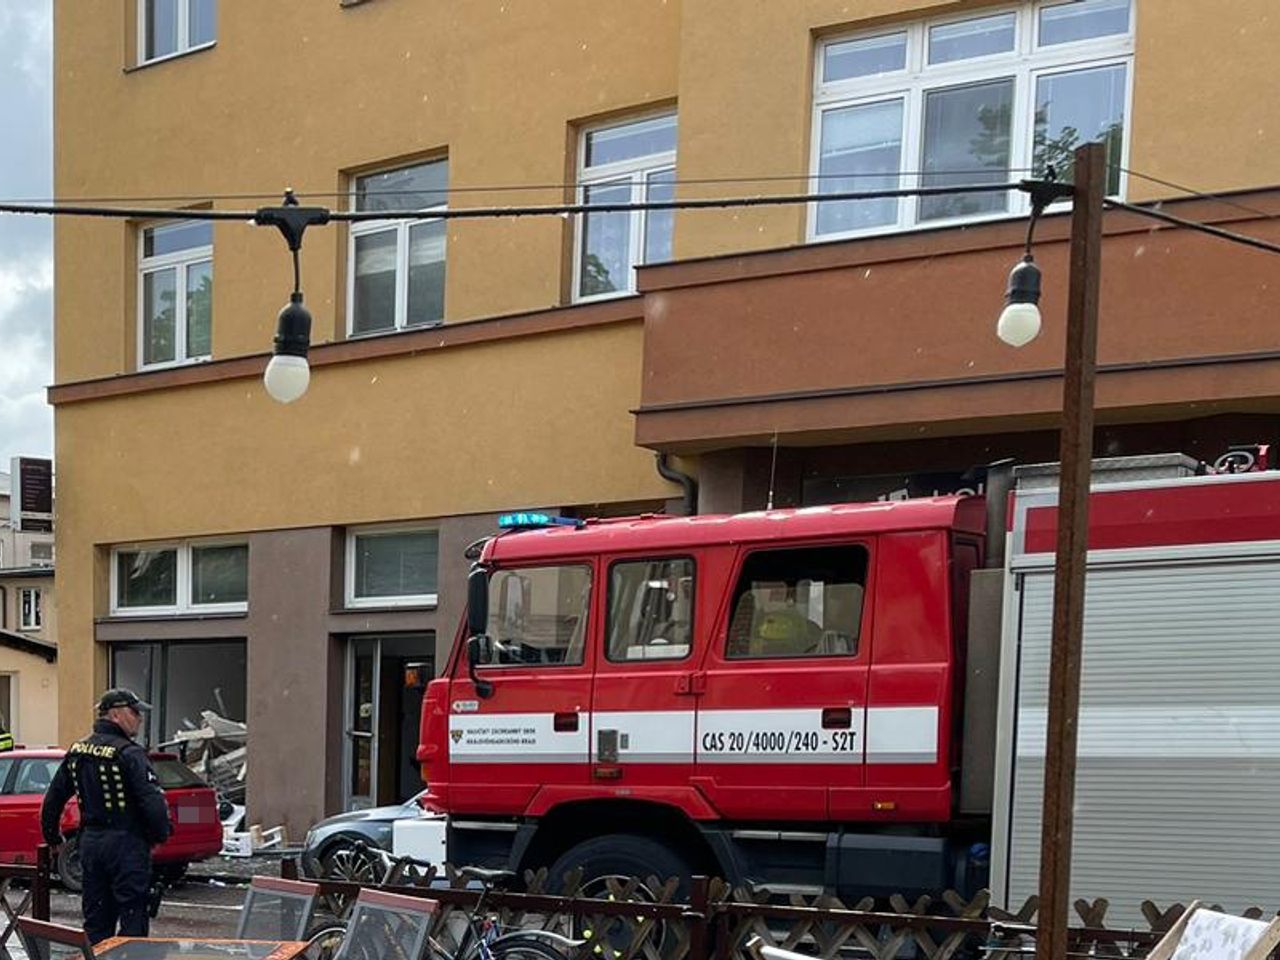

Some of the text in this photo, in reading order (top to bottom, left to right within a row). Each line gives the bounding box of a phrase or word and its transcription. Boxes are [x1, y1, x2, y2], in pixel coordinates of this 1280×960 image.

[71, 742, 117, 758] POLICIE
[702, 732, 725, 751] CAS
[728, 730, 819, 753] 20/4000/240
